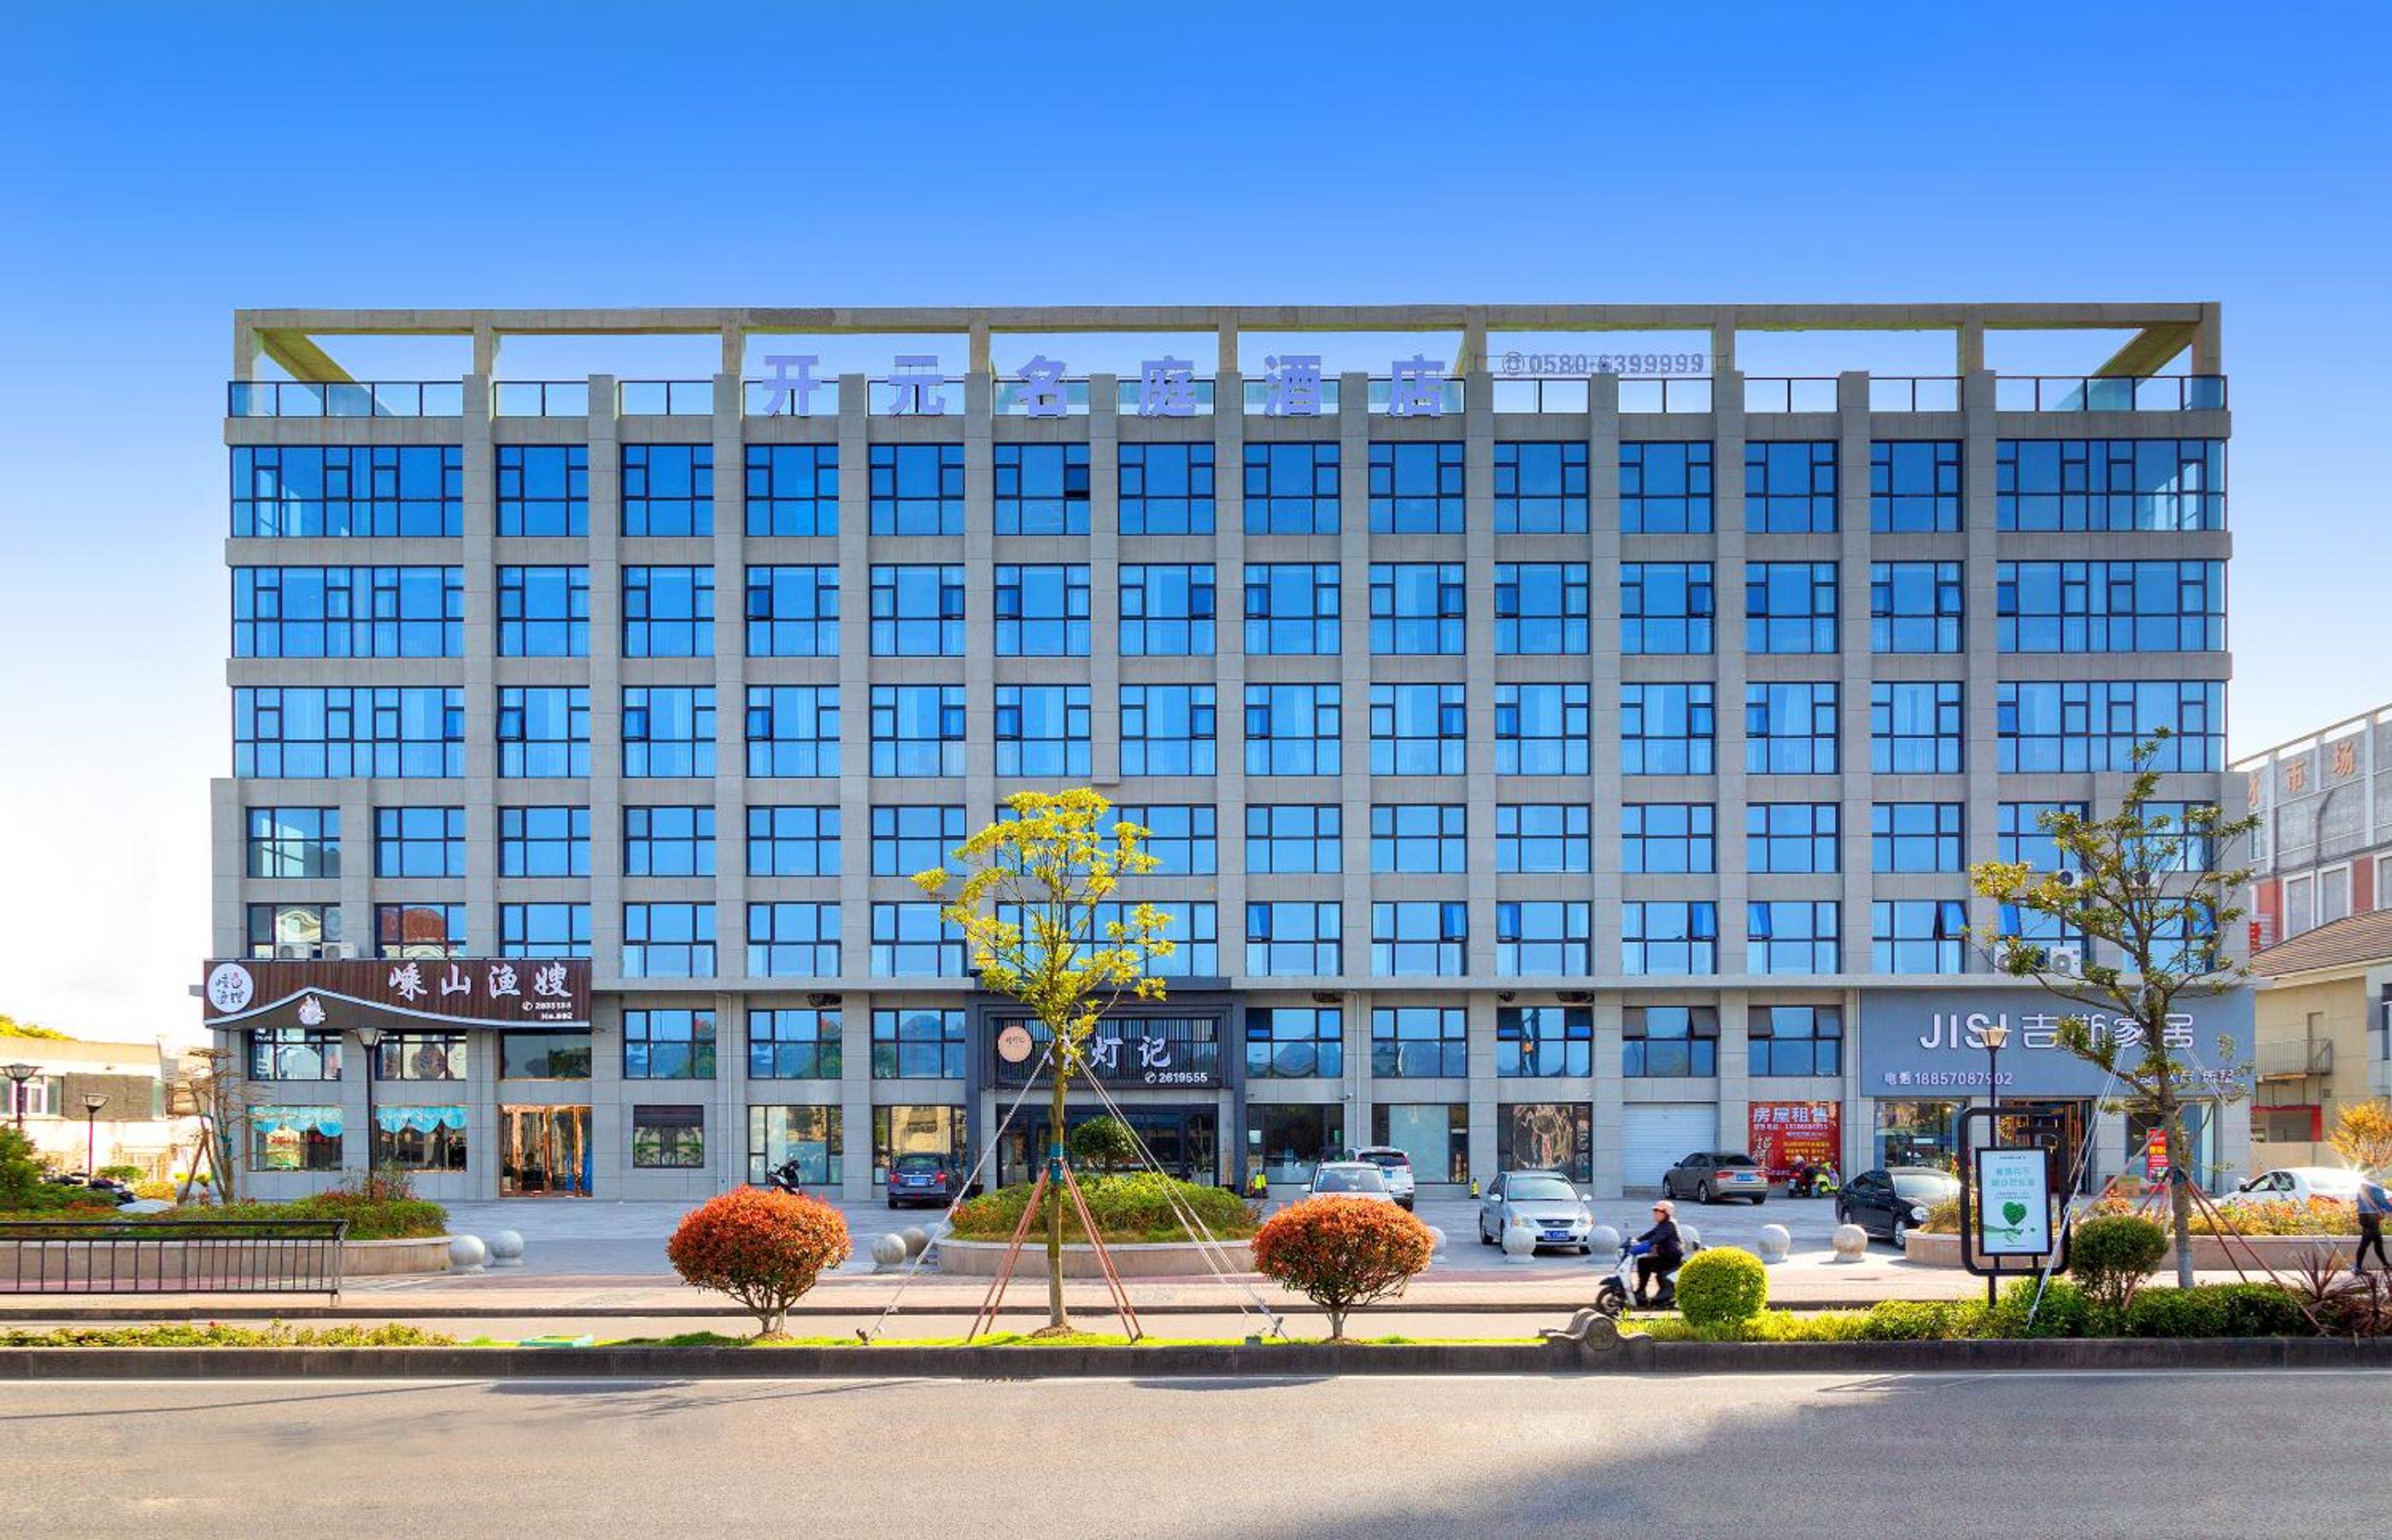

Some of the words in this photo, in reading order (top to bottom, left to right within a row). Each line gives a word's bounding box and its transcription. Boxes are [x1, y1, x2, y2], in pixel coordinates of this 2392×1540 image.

[762, 354, 1445, 418] 开元名庭酒店
[388, 962, 572, 1002] 嵊山渔嫂
